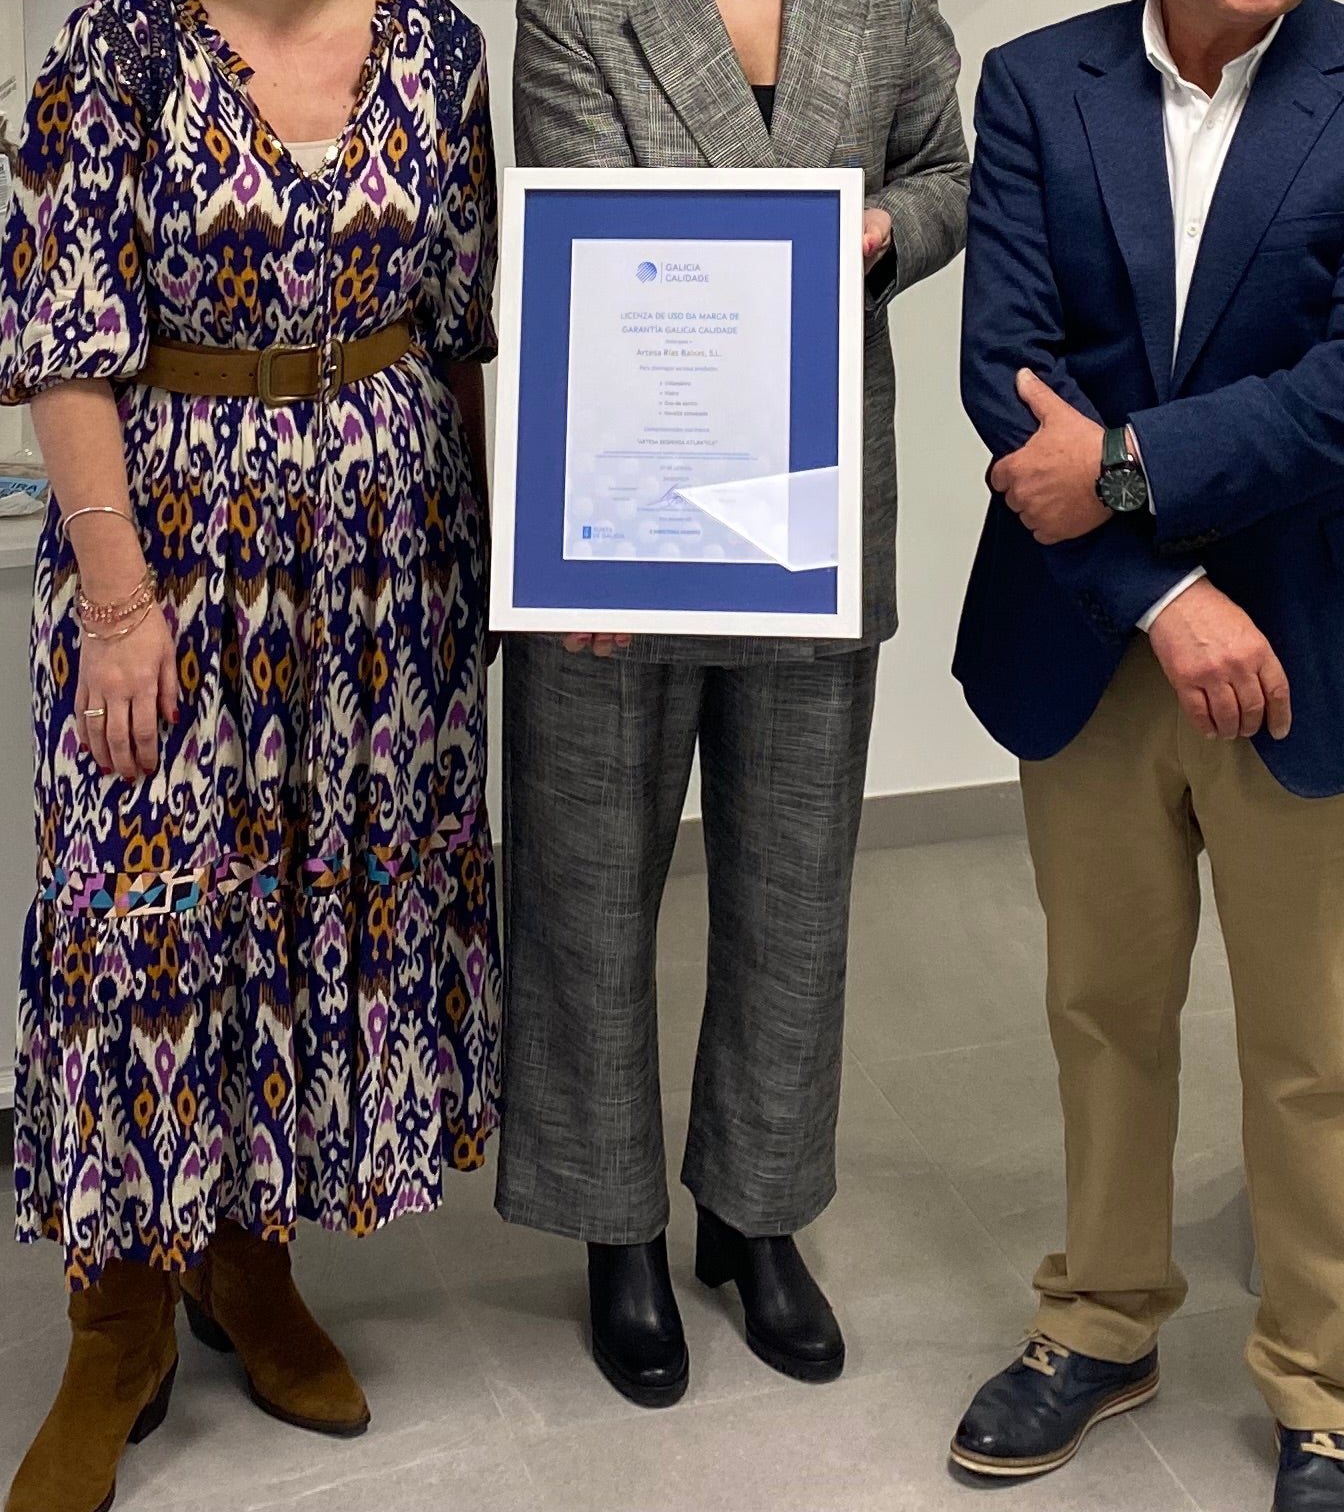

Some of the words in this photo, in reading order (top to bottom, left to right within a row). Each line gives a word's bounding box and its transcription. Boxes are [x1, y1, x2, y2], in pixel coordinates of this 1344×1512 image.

[665, 263, 701, 272] GALICIA
[665, 274, 710, 283] CALIDADE
[620, 311, 654, 320] LICENZA
[655, 311, 666, 320] DE
[667, 311, 684, 320] USO
[699, 311, 727, 321] MARCA
[622, 324, 663, 334] GARANTÍA
[698, 325, 738, 335] CALIDADE
